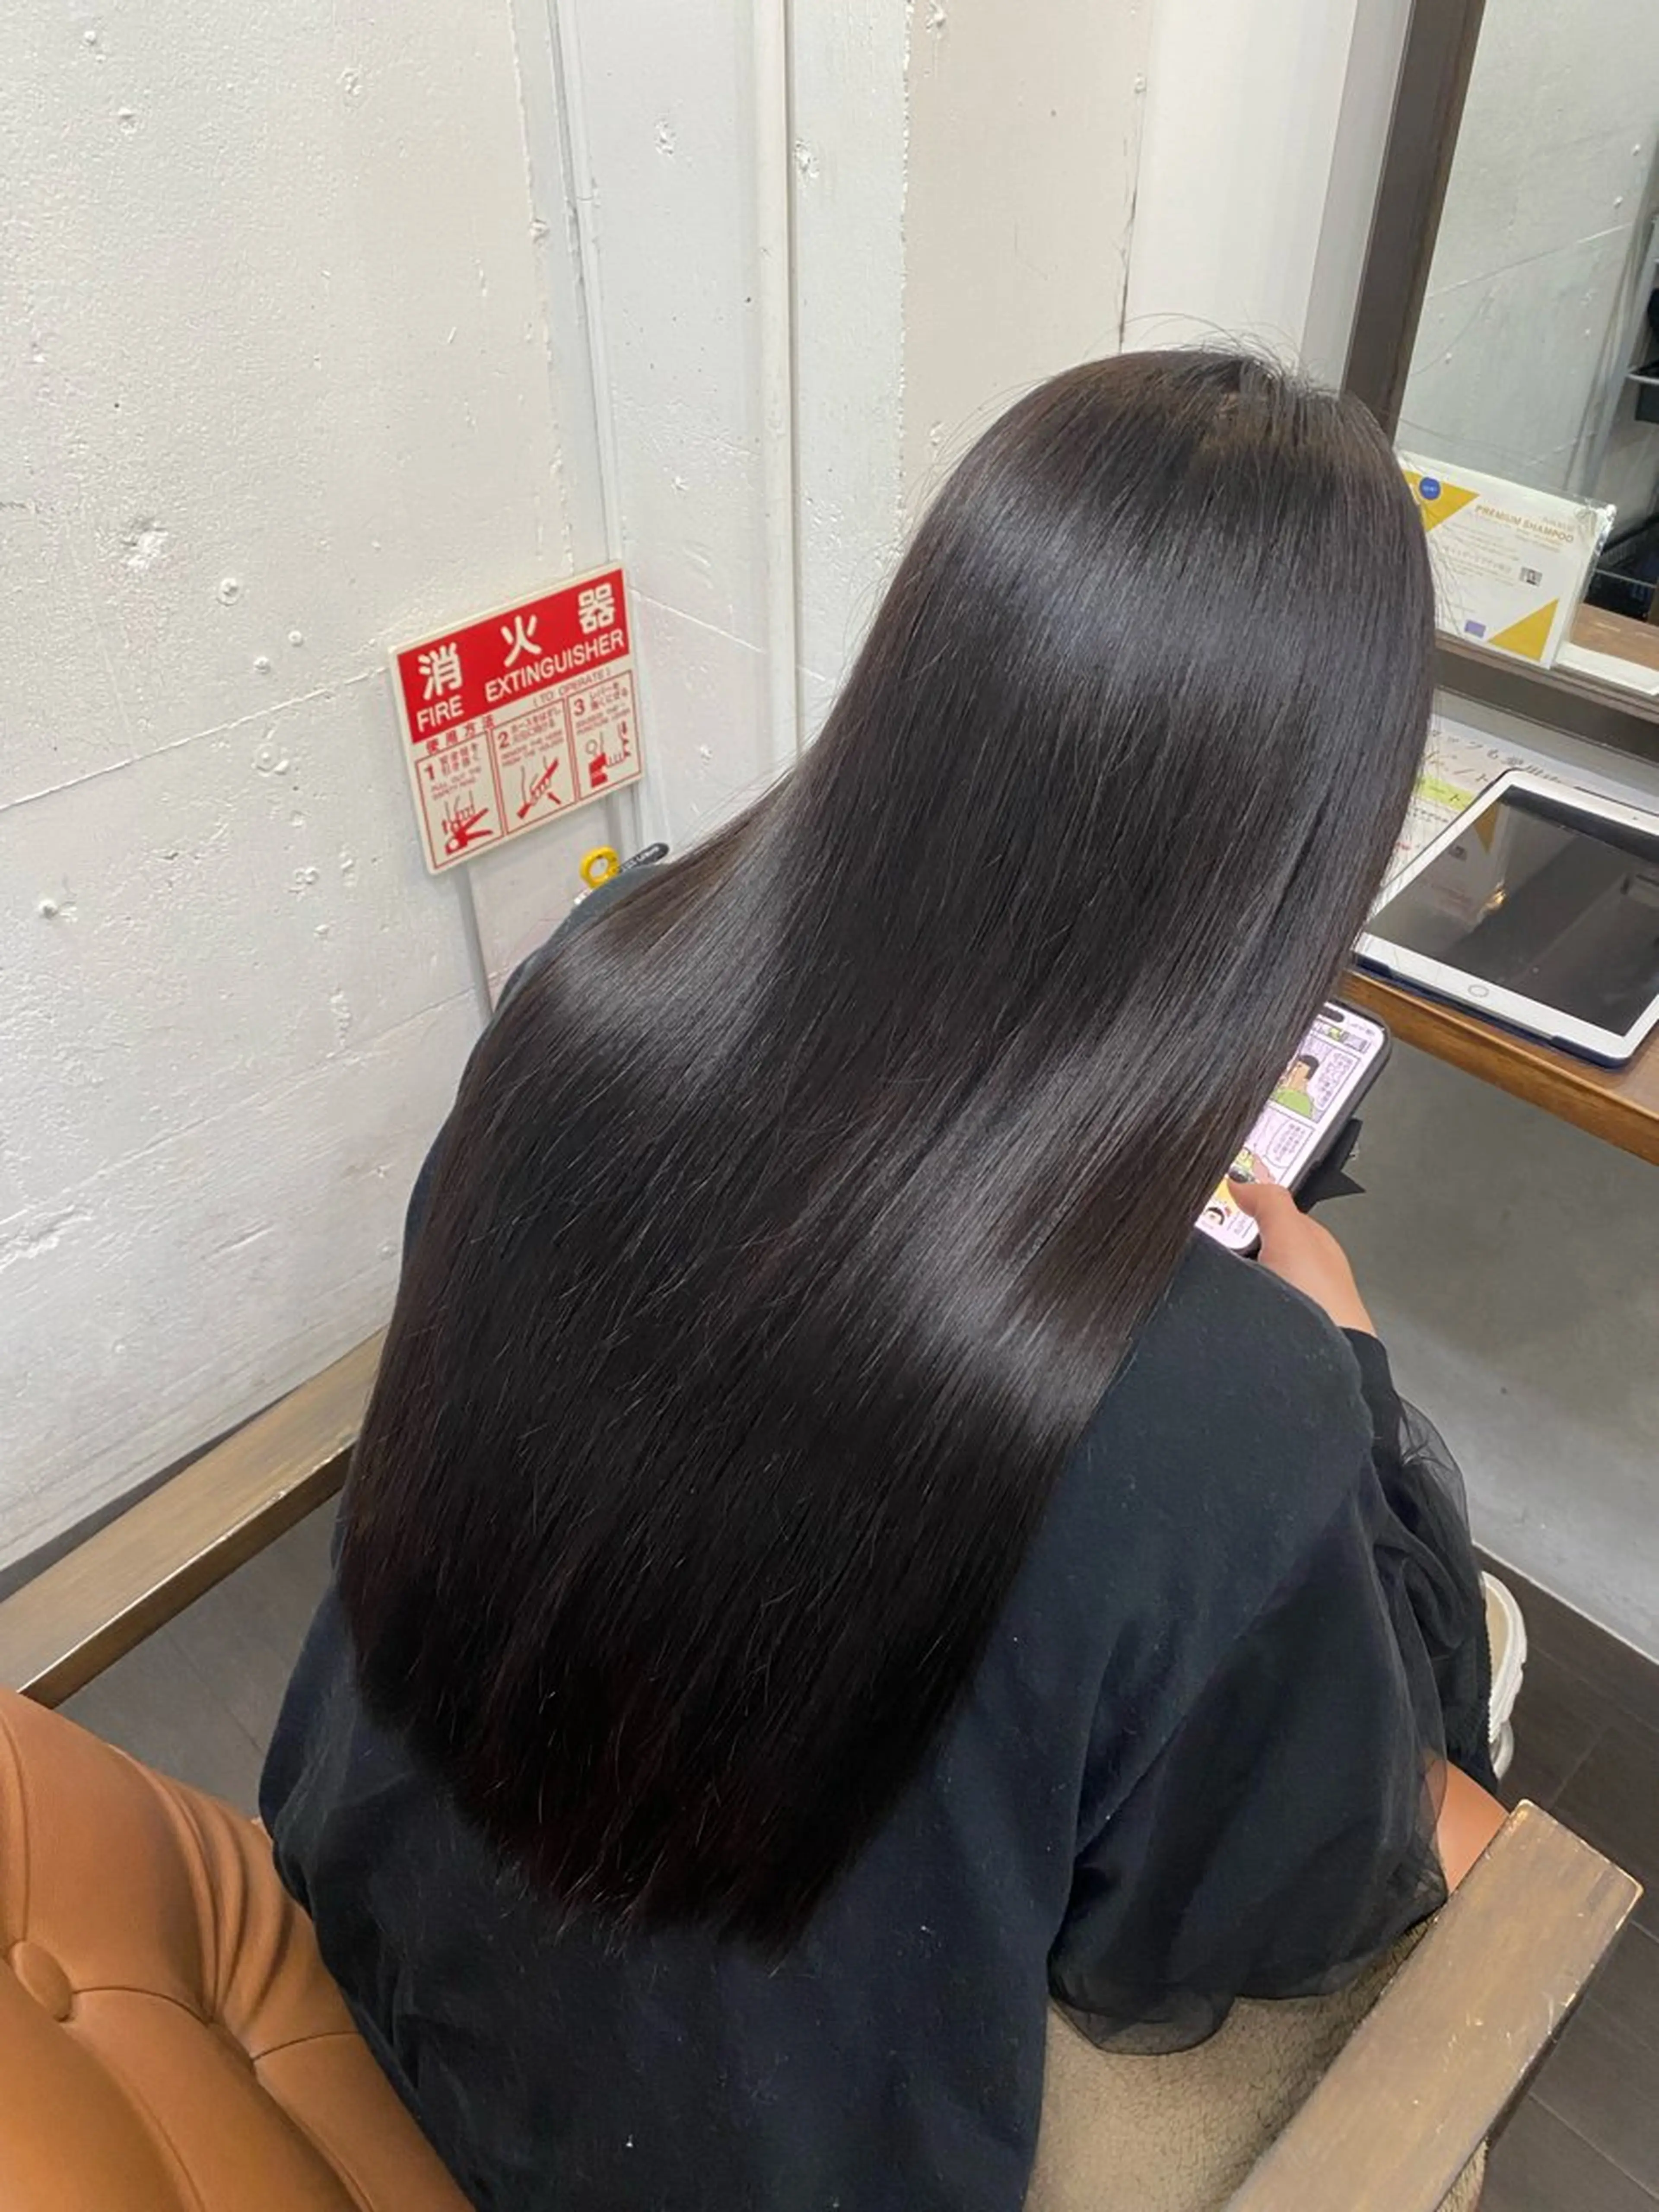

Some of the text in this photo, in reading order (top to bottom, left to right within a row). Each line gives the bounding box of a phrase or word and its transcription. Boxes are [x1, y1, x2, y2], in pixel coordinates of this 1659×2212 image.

[1523, 519, 1574, 543] SHAMPOO
[418, 582, 616, 699] 消火器
[416, 628, 624, 732] FIRE EXTINGUISHER
[573, 696, 585, 718] 3
[497, 729, 509, 750] 2
[424, 763, 435, 782] 1
